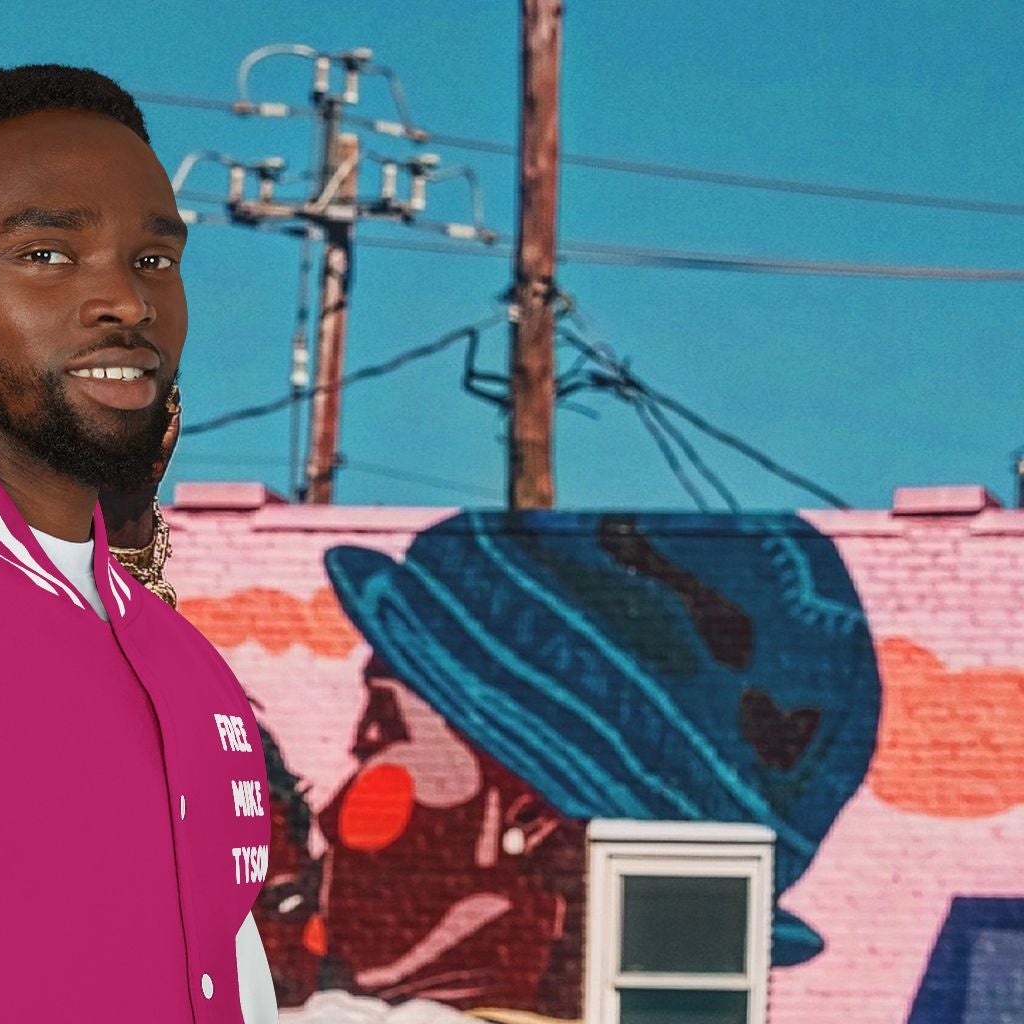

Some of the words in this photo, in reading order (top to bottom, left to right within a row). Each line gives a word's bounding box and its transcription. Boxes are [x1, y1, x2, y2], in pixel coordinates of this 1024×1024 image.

[214, 713, 252, 752] FREE
[231, 780, 264, 817] MIKE
[232, 845, 268, 884] TYSON
